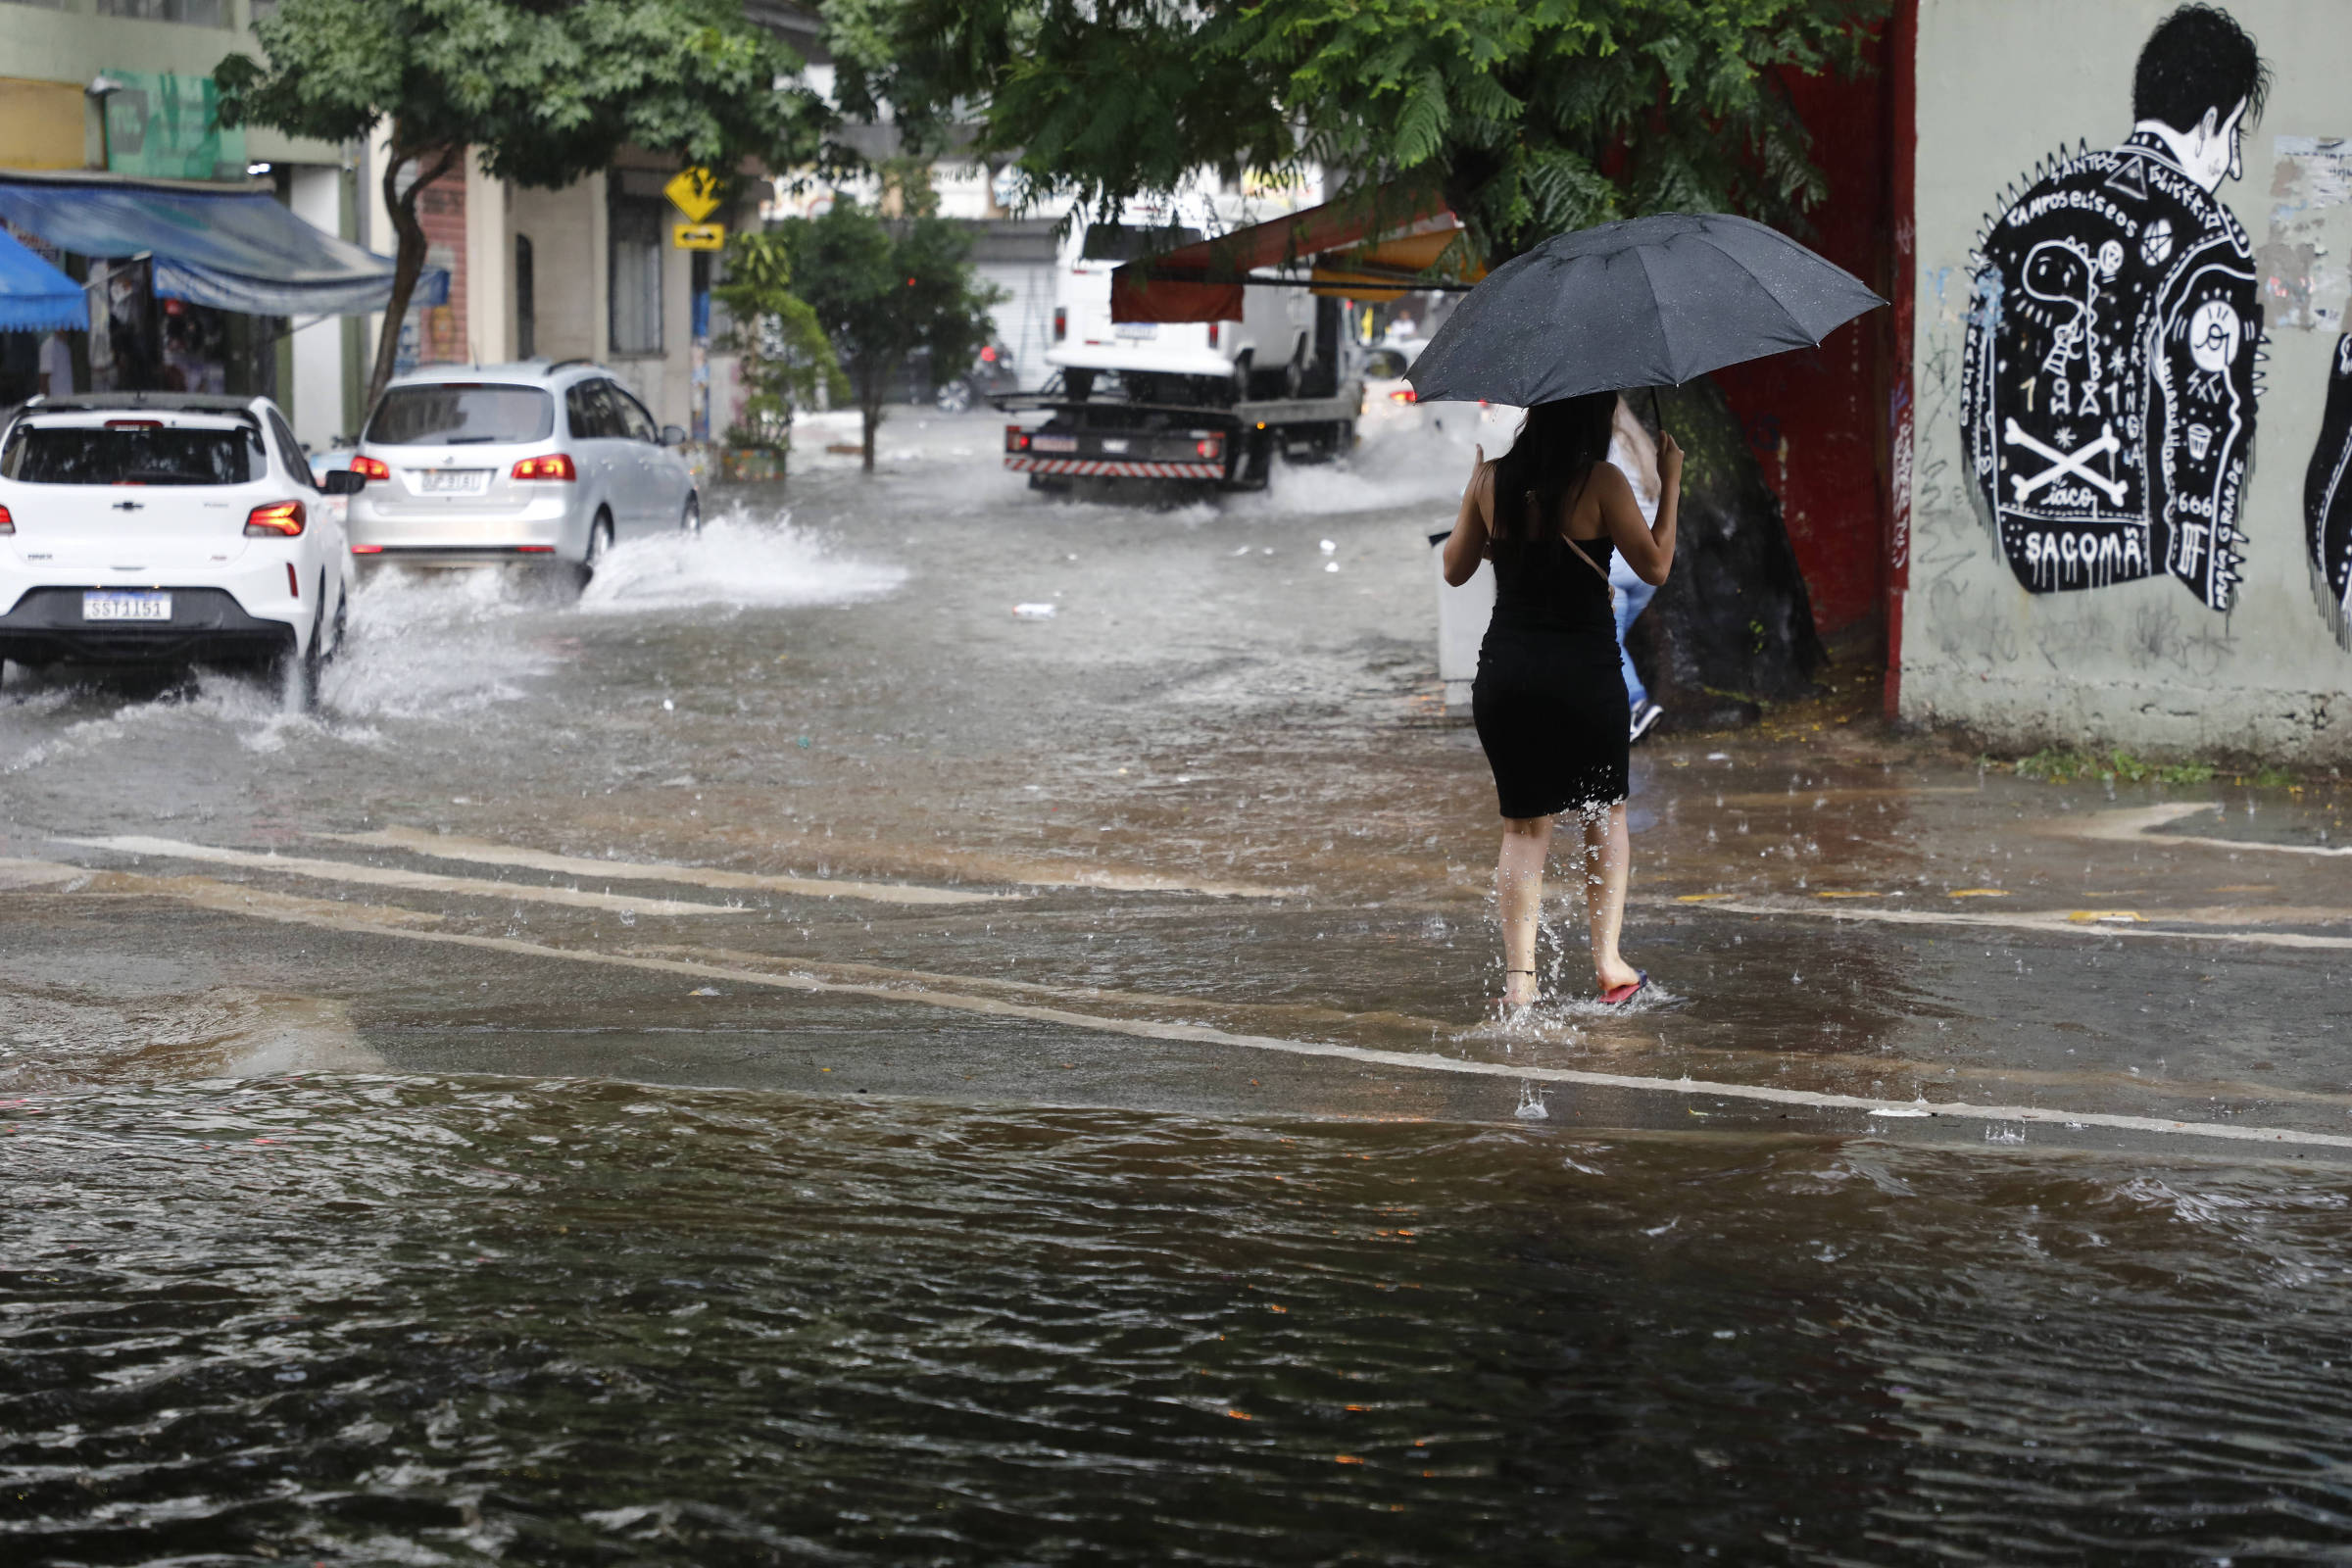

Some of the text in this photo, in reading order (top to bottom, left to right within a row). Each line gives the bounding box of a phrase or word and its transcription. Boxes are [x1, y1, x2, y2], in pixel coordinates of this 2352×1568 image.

[2050, 151, 2122, 185] SANTOS
[2007, 190, 2069, 227] CAMPOS
[2179, 491, 2213, 518] 666
[2026, 526, 2141, 564] SACOMÃ
